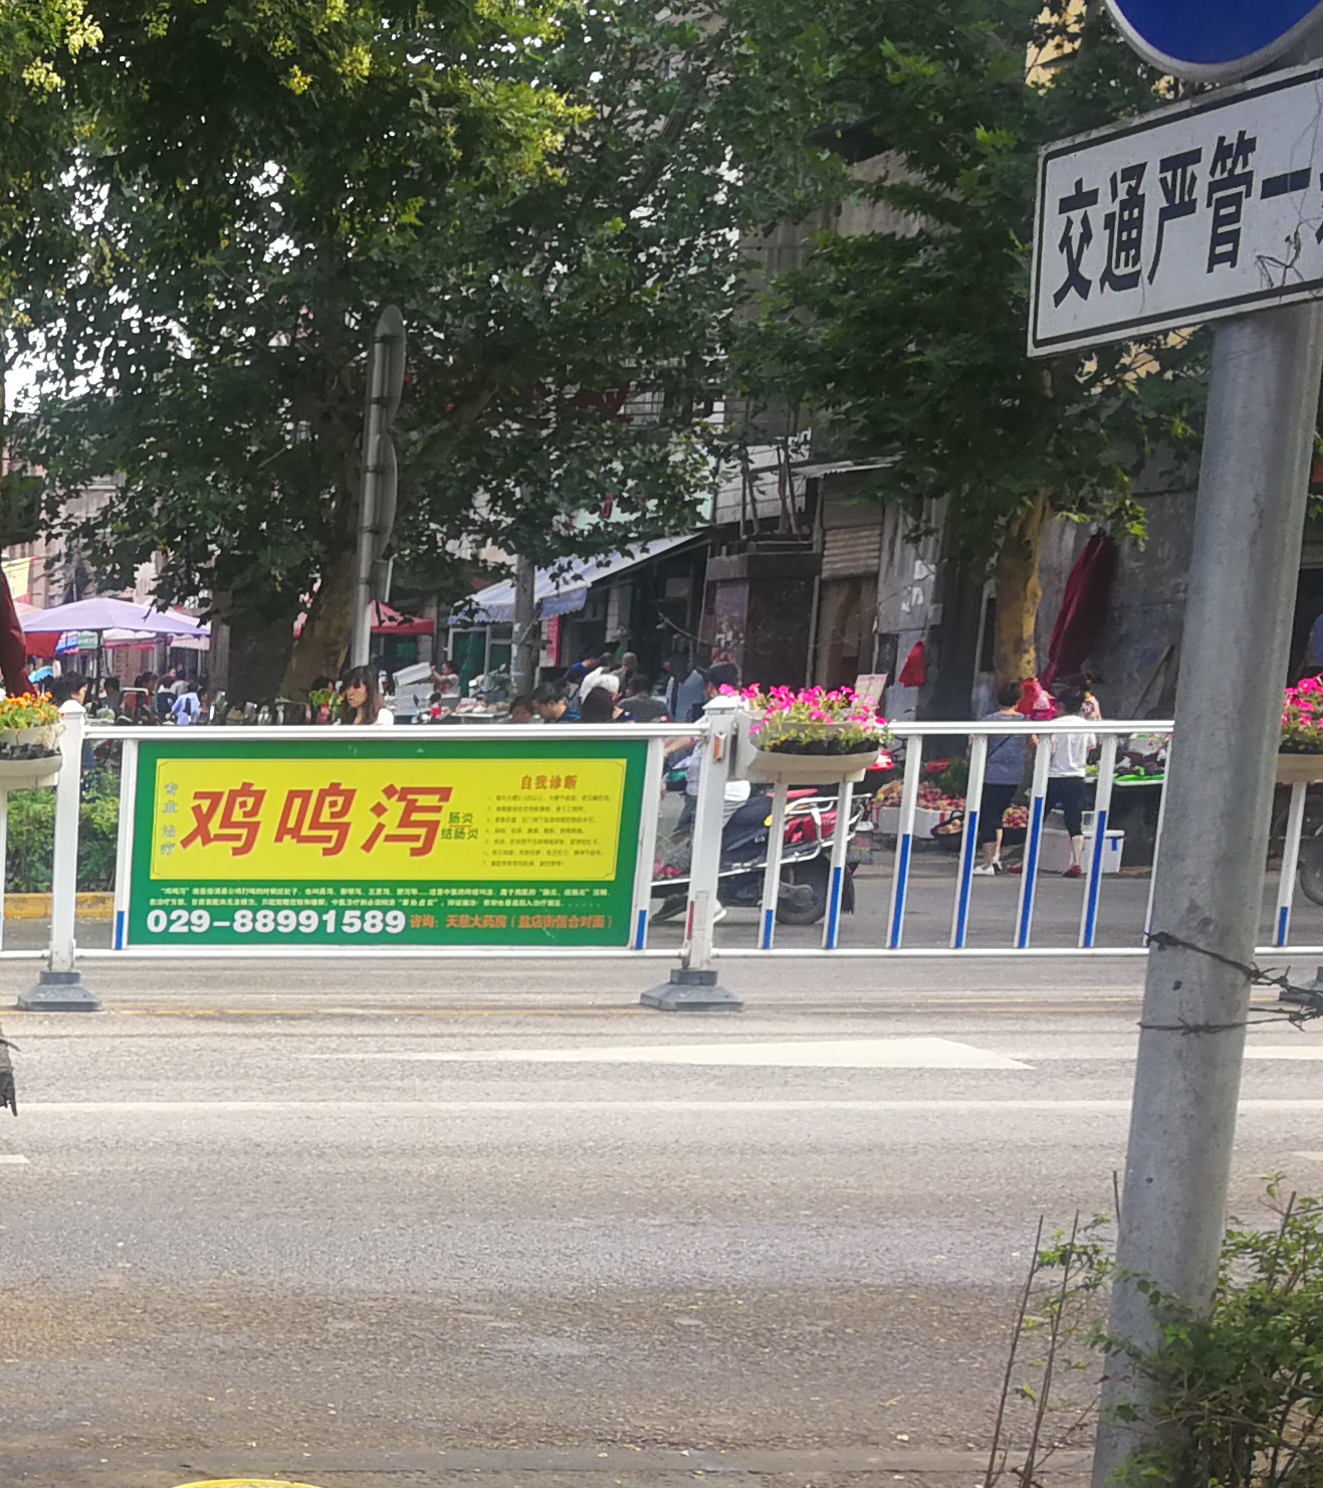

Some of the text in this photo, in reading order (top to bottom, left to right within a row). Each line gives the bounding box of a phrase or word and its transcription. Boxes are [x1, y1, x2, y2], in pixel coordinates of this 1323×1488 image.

[1053, 130, 1323, 308] 交通严管一
[520, 774, 578, 791] 自我诊断
[179, 781, 454, 858] 鸡鸣泻
[447, 811, 474, 825] 肠炎
[440, 826, 479, 841] 结肠炎
[146, 908, 406, 934] 029-88991589
